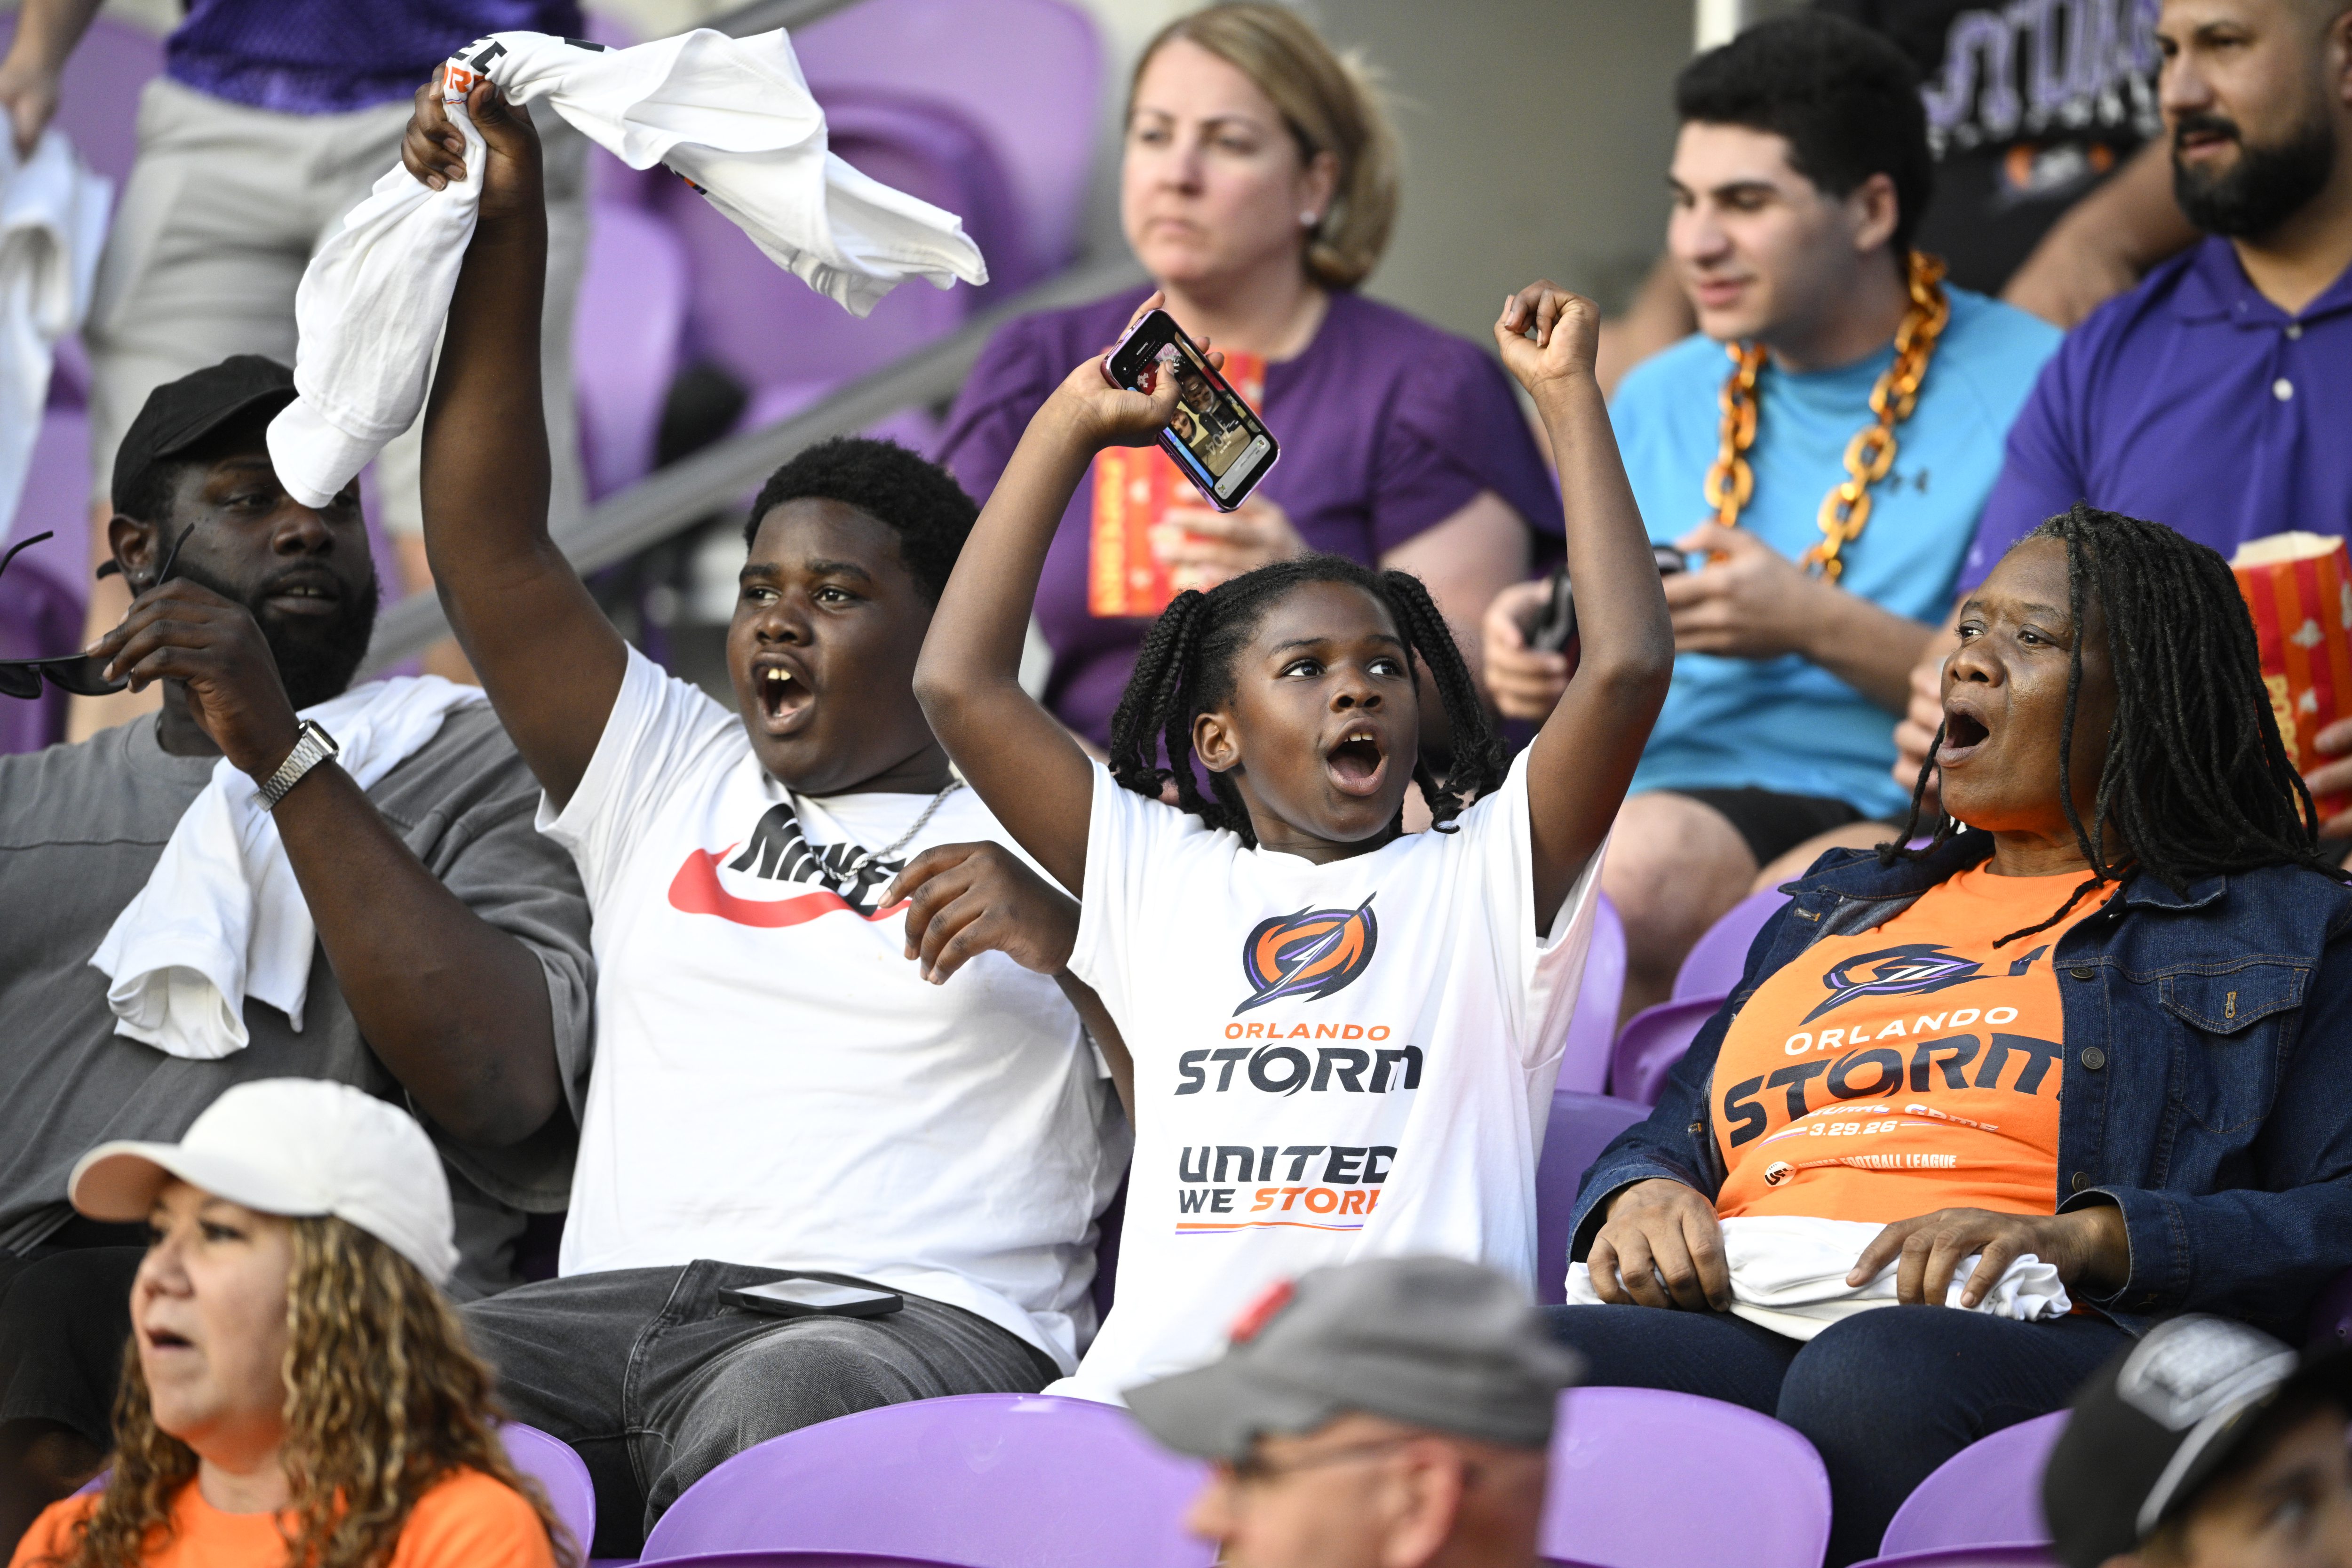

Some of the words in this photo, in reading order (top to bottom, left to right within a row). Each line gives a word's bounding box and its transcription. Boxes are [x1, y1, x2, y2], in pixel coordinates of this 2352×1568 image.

[1225, 1023, 1391, 1041] ORLANDO
[1784, 1006, 2018, 1056] ORLANDO
[1174, 1043, 1423, 1098] STORM
[1724, 1033, 2064, 1148] STORM
[1809, 1120, 1898, 1136] 3.29.26
[1178, 1146, 1398, 1185] UNITED
[1839, 1154, 1904, 1169] FOOTBALL
[1906, 1154, 1957, 1169] LEAGUE
[1179, 1189, 1236, 1214] WE
[1249, 1187, 1381, 1215] STOR
